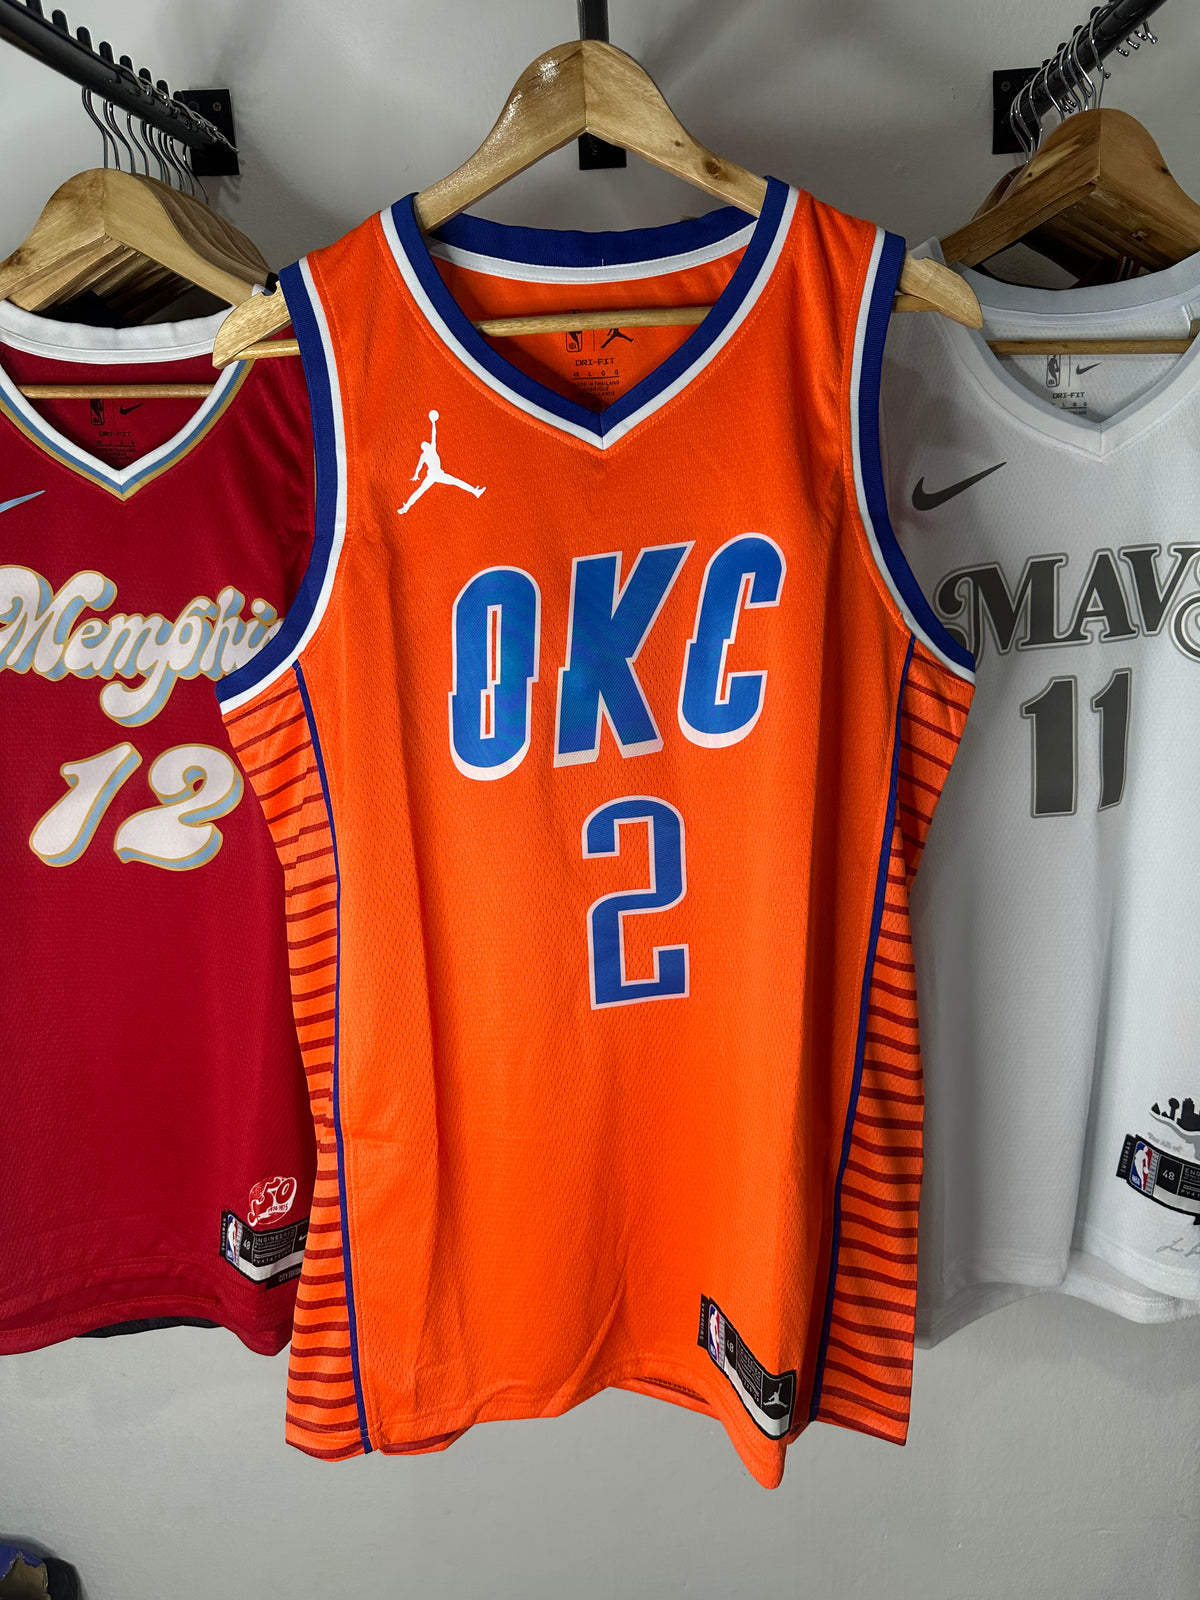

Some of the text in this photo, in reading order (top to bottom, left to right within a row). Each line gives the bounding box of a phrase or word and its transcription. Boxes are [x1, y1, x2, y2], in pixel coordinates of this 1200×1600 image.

[575, 358, 615, 367] DRI-FIT
[1052, 391, 1085, 399] DRI-FIT
[0, 564, 286, 728] Memphi
[447, 531, 788, 782] OKC
[935, 541, 1200, 673] MAV
[29, 741, 244, 872] 12
[1019, 667, 1133, 819] 11
[581, 794, 690, 1010] 2
[247, 1176, 297, 1226] 50
[1162, 1168, 1175, 1181] 48
[243, 1239, 251, 1250] 48
